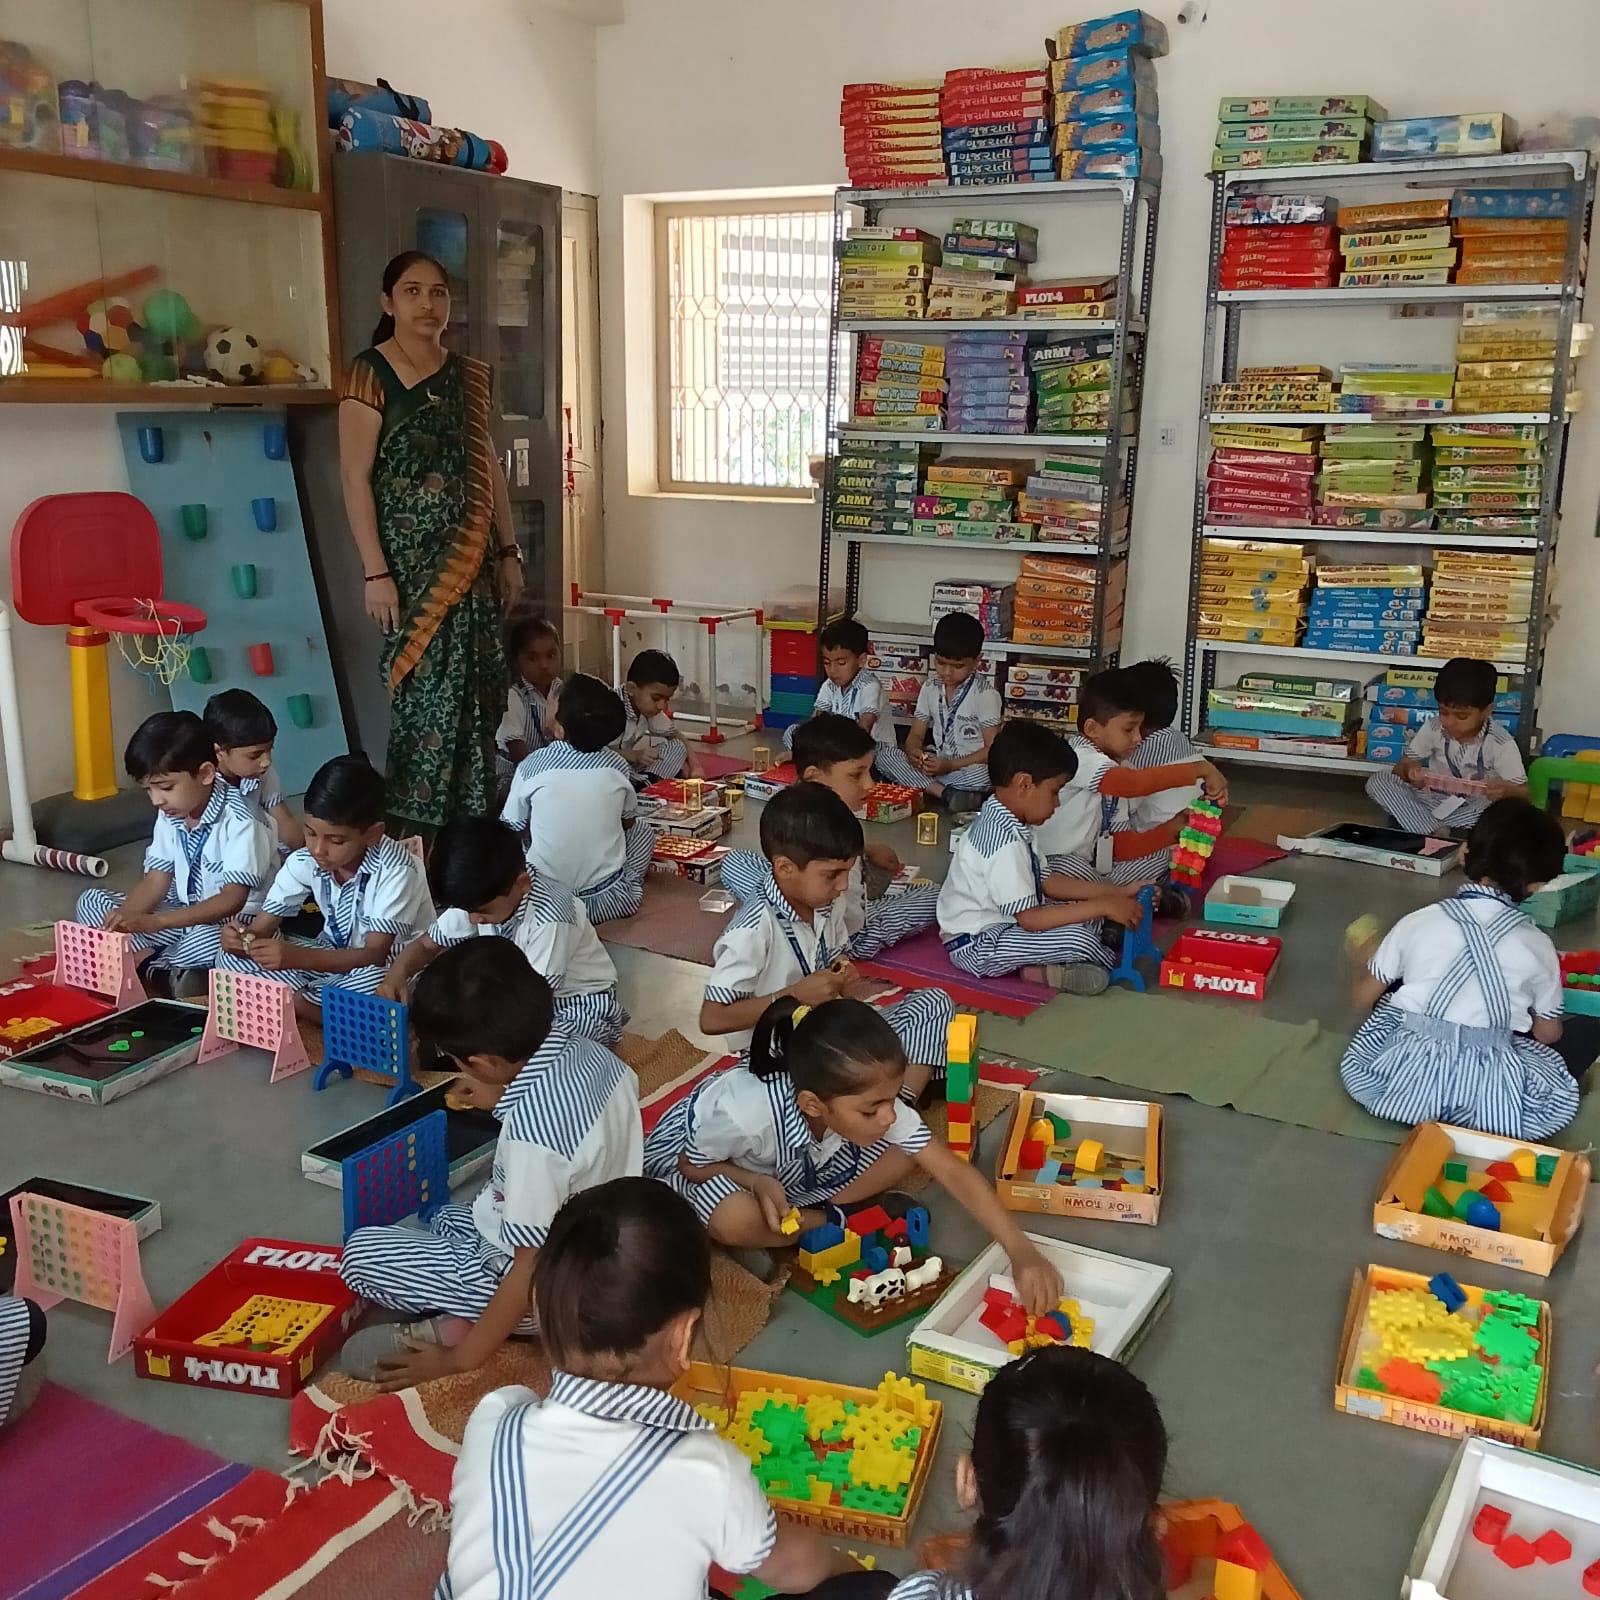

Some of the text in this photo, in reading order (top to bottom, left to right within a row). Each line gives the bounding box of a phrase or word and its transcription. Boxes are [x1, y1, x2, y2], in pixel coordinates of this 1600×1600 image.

[993, 80, 1024, 88] MOSAIC
[992, 110, 1023, 118] MOSAIC
[959, 149, 1012, 162] ગુજરાતી
[960, 161, 1012, 174] ગુજરાતી
[1025, 291, 1063, 304] PLOT-4
[1034, 346, 1071, 360] ARMY
[1225, 383, 1255, 391] FIRST
[1257, 383, 1286, 391] PLAY
[1289, 383, 1320, 391] PACK
[1287, 393, 1318, 401] PACK
[840, 458, 876, 469] ARMY
[837, 476, 874, 487] ARMY
[836, 495, 872, 505] ARMY
[836, 514, 871, 526] ARMY
[1275, 682, 1292, 690] FARM
[1194, 930, 1269, 945] PLOT-4
[1193, 973, 1257, 995] PLOT-4
[1064, 1197, 1133, 1212] TOY TOWN
[1440, 1231, 1480, 1248] TOWN
[243, 1246, 341, 1272] PLOT-
[184, 1356, 281, 1390] PLOT-4
[820, 1521, 895, 1543] HAPPY
